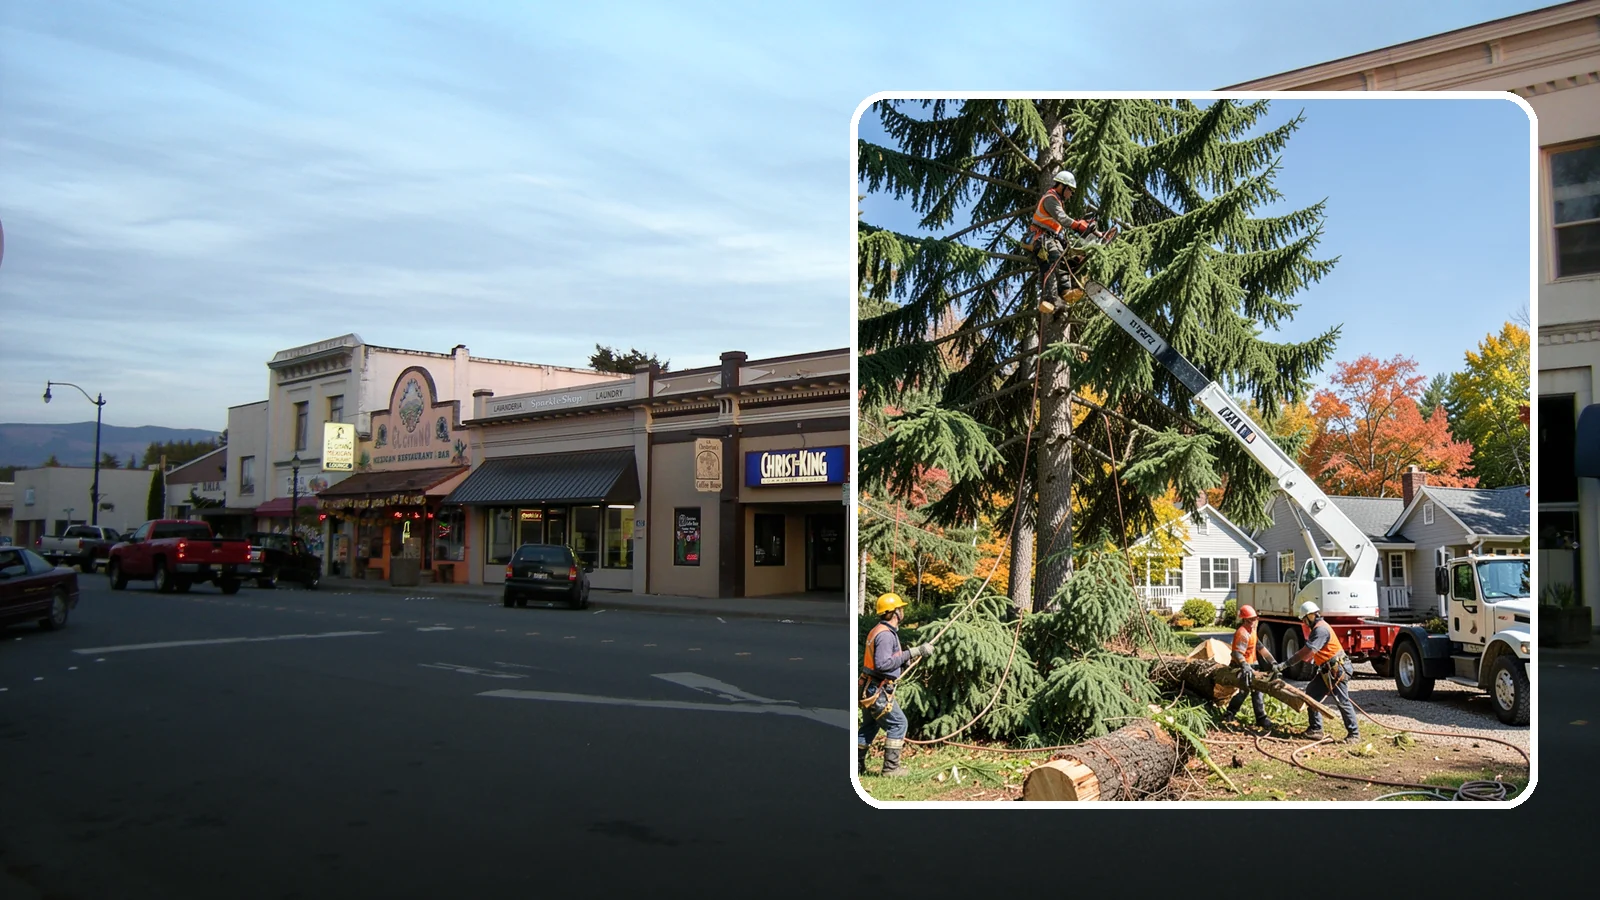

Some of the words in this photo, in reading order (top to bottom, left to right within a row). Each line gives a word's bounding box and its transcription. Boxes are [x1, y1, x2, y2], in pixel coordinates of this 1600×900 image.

[595, 389, 623, 400] LAUNDRY
[493, 402, 522, 412] LAVANDERIA
[397, 451, 433, 462] RESTAURANT
[437, 450, 450, 459] BAR
[761, 452, 797, 478] CHRIST
[799, 450, 827, 476] KING
